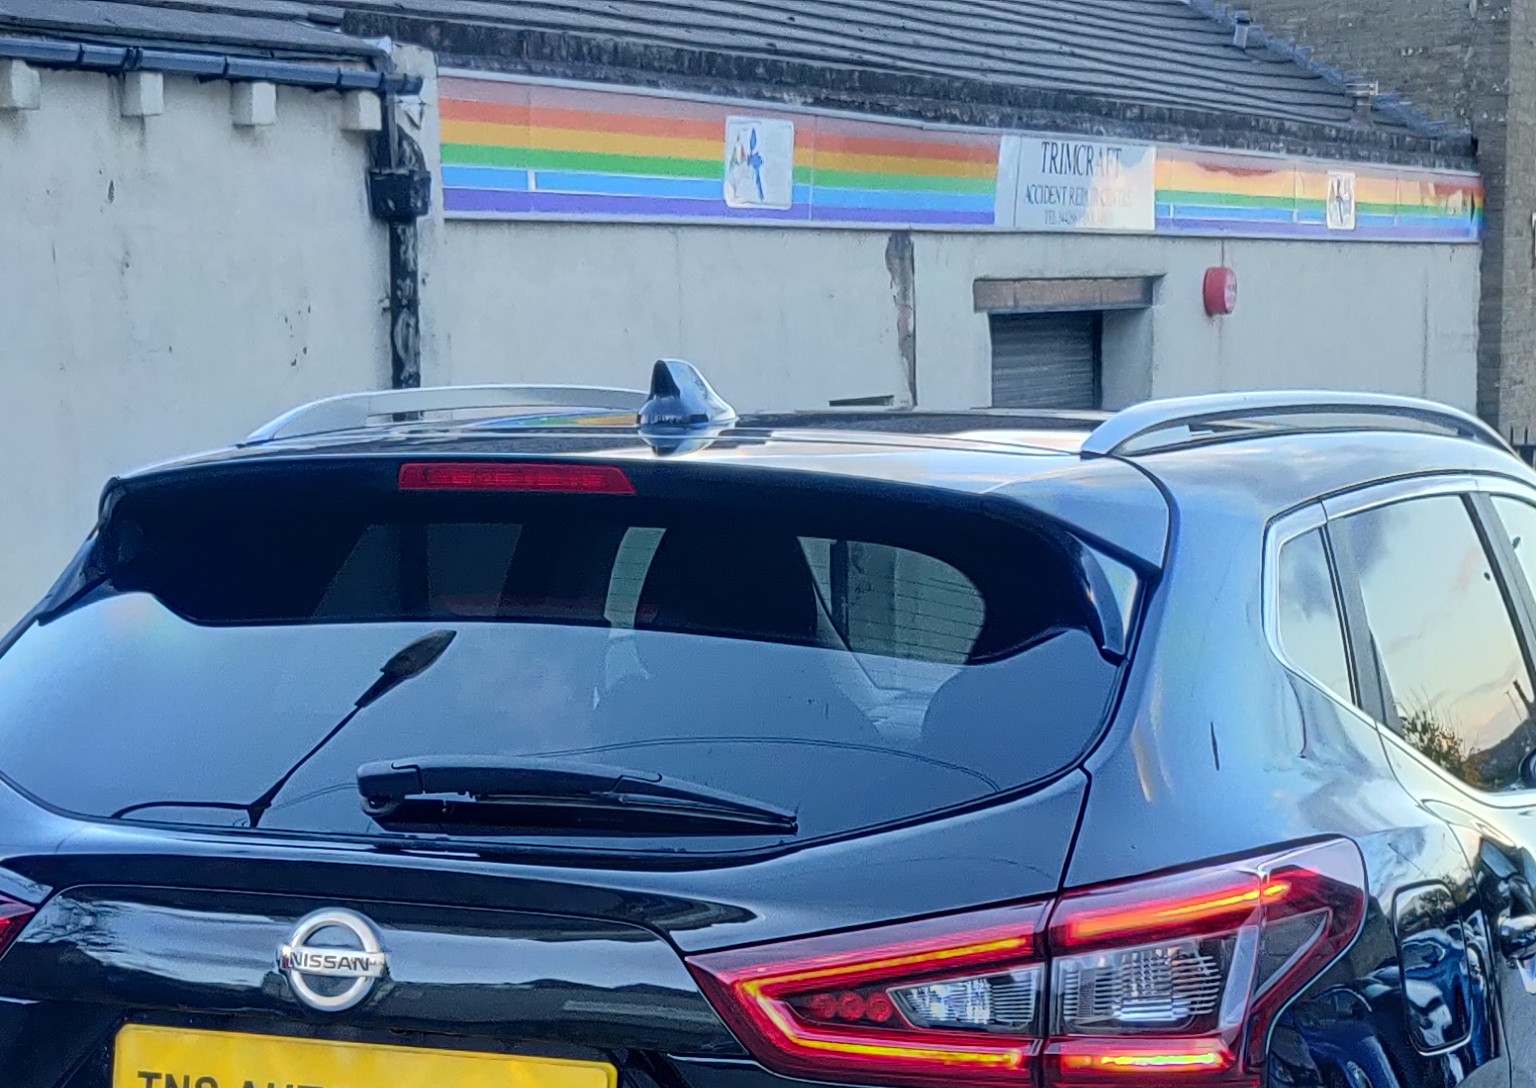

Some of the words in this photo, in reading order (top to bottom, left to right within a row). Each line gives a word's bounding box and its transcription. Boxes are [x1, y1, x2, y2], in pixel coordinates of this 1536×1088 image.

[1041, 141, 1122, 180] TRIMCRAFT
[1026, 184, 1067, 206] ACCIDENT
[290, 951, 370, 972] NISSAN
